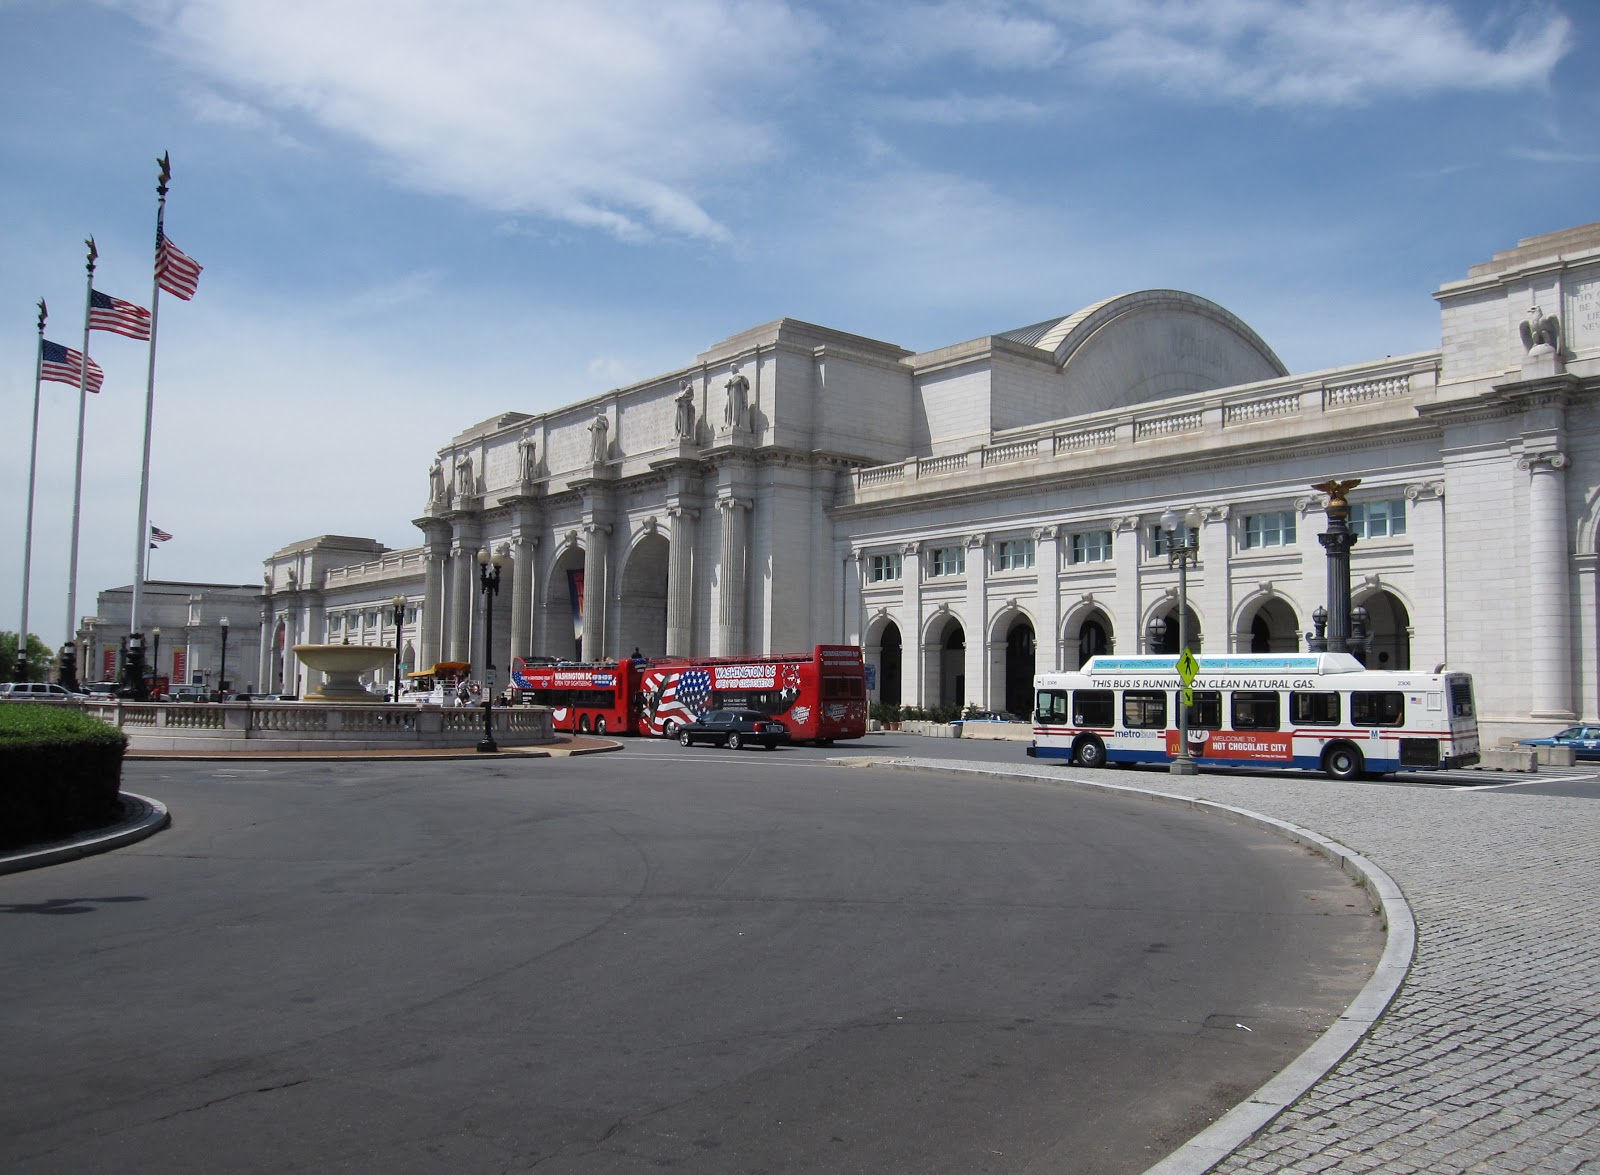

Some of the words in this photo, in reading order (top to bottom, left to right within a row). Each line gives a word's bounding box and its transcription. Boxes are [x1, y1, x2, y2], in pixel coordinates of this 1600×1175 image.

[554, 672, 585, 680] WASHINGTON
[585, 672, 592, 680] DC
[714, 666, 765, 679] WASHINGTON
[765, 665, 776, 677] DC
[715, 679, 729, 688] OPEN
[729, 679, 738, 688] TOP
[739, 678, 775, 688] SIGHTSEEING
[1092, 680, 1111, 688] THIS
[1113, 680, 1131, 688] BUS
[1133, 680, 1140, 688] IS
[1142, 680, 1183, 688] RUNNIN
[1190, 680, 1204, 688] ON
[1208, 680, 1240, 689] CLEAN
[1243, 680, 1290, 689] NATURAL
[1292, 680, 1316, 689] GAS.
[1115, 729, 1157, 739] metrobus
[1212, 742, 1226, 750] HOT
[1228, 742, 1268, 751] CHOCOLATE
[1270, 744, 1287, 752] CITY
